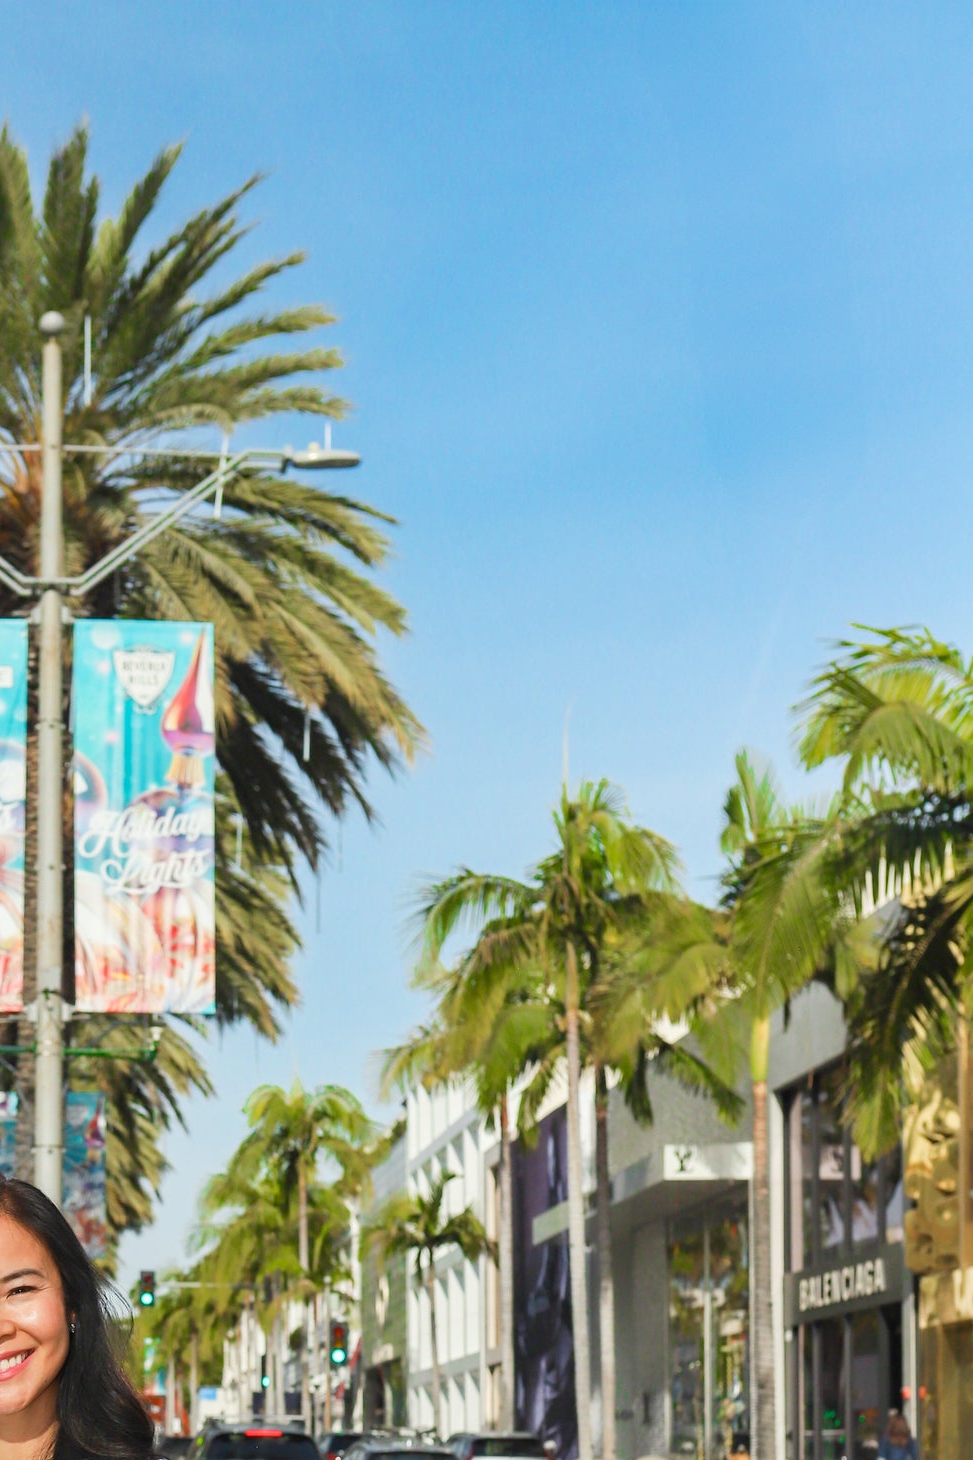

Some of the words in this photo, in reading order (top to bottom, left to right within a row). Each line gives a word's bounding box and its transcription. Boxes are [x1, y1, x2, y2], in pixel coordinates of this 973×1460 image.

[78, 806, 203, 858] Holiday
[99, 848, 211, 895] Lights
[799, 1257, 886, 1312] BALENCIAGA
